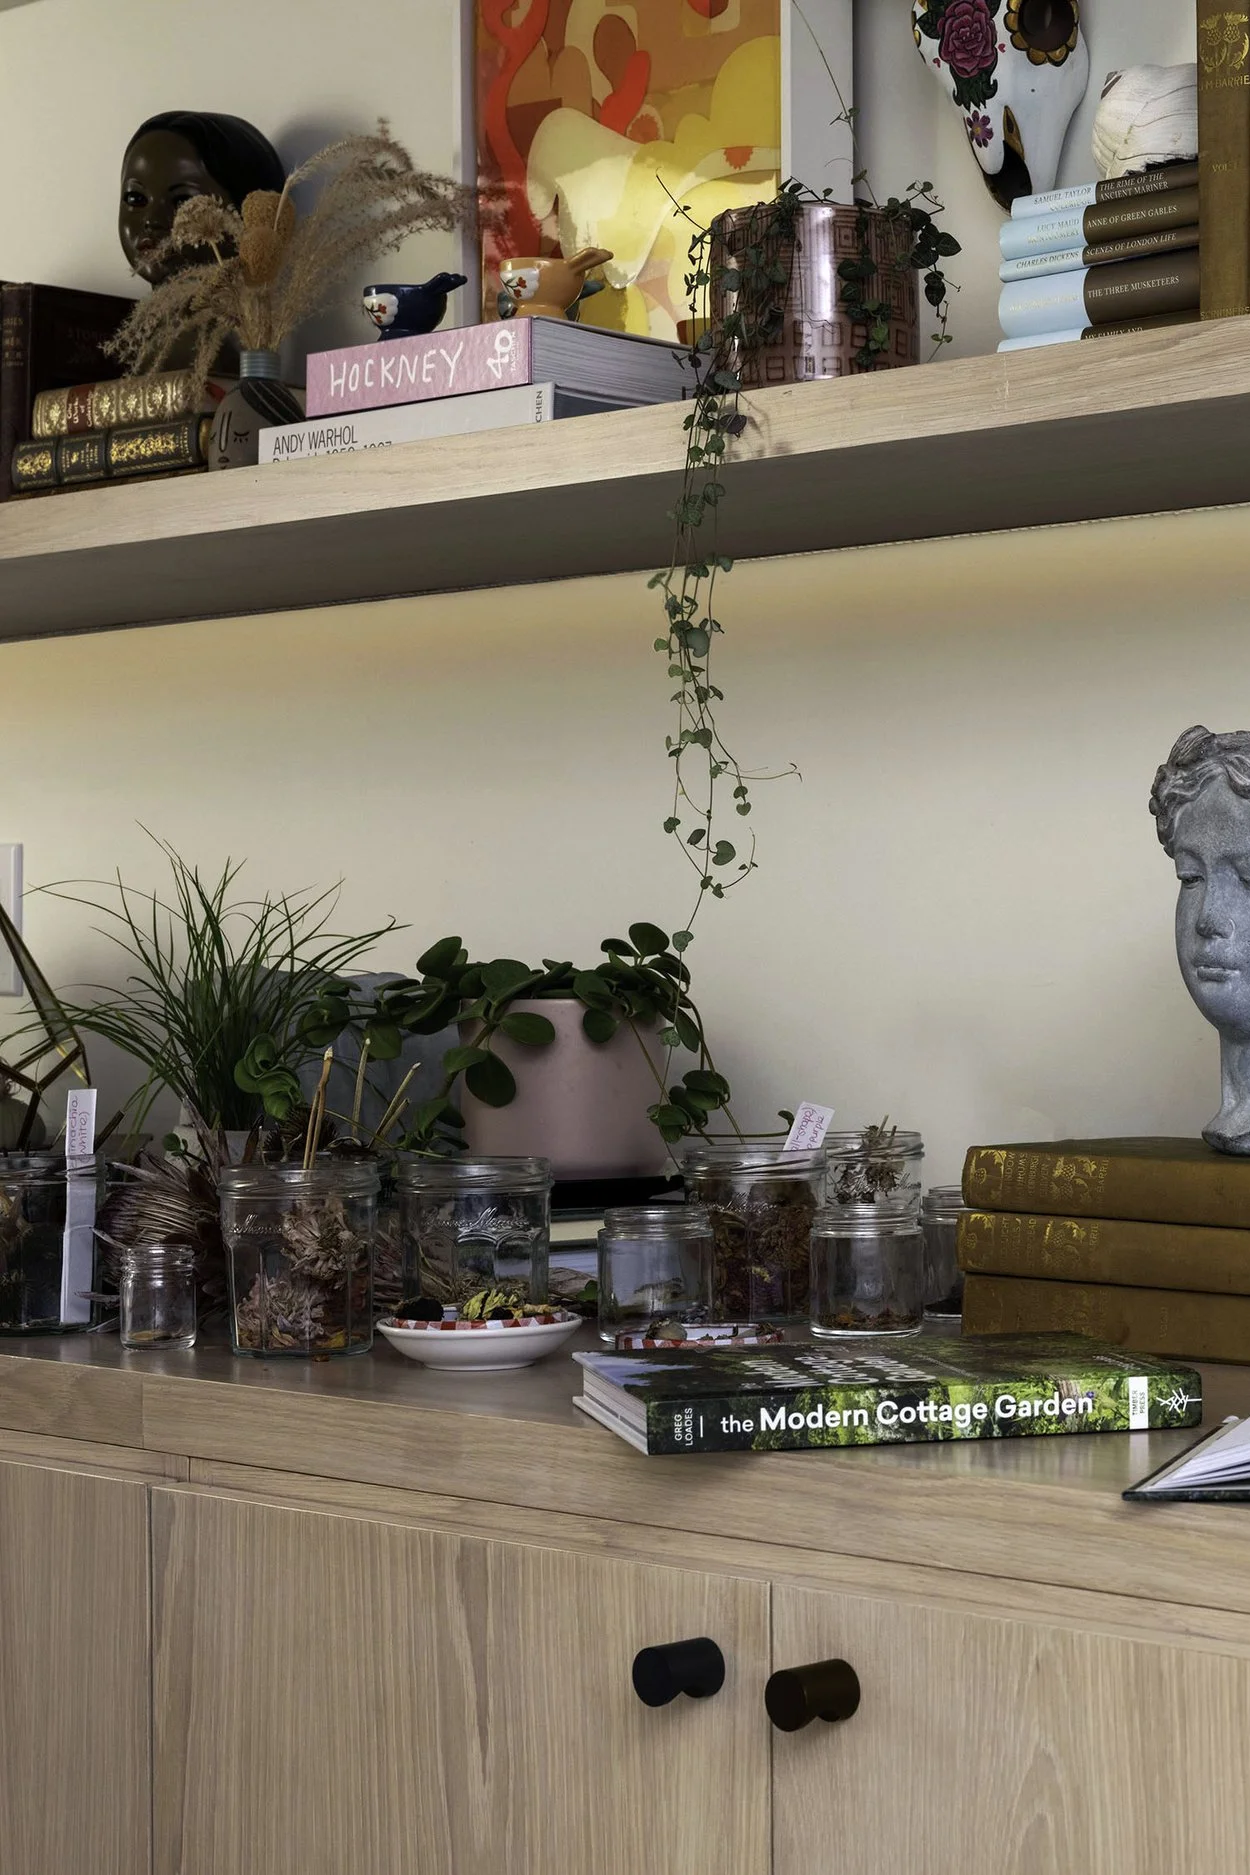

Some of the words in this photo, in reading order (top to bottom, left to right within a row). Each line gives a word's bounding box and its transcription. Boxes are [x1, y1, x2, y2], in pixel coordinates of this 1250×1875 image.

[1100, 182, 1115, 192] THE
[1117, 178, 1135, 188] RIME
[1137, 175, 1148, 185] OF
[1149, 172, 1164, 183] THE
[1100, 189, 1133, 201] ANCIENT
[1134, 181, 1169, 195] MARINER
[1034, 191, 1062, 204] SAMUEL
[1064, 187, 1092, 200] TAYLOR
[1058, 218, 1080, 229] MAUD
[1086, 218, 1108, 229] ANNE
[1109, 215, 1120, 225] OF
[1121, 211, 1147, 222] GREEN
[1148, 205, 1177, 217] GABLES
[1086, 244, 1113, 256] SCENES
[1114, 242, 1126, 251] OF
[1126, 236, 1160, 249] LONDON
[1160, 232, 1177, 243] LIFE
[1016, 257, 1048, 269] CHARLES
[1049, 251, 1079, 263] DICKENS
[1087, 290, 1103, 299] THE
[1104, 285, 1129, 296] THREE
[1131, 275, 1179, 291] MUSKETEERS
[329, 341, 464, 398] HOCKNEY
[273, 433, 305, 455] ANDY
[308, 425, 358, 450] WARHOL
[741, 1360, 825, 1388] Modern
[794, 1355, 879, 1384] Cottage
[854, 1355, 937, 1382] Garden
[720, 1413, 755, 1434] the
[759, 1403, 870, 1432] Modern
[876, 1395, 988, 1429] Cottage
[994, 1389, 1094, 1418] Garden
[674, 1414, 683, 1441] GREG
[684, 1407, 694, 1446] LOADES
